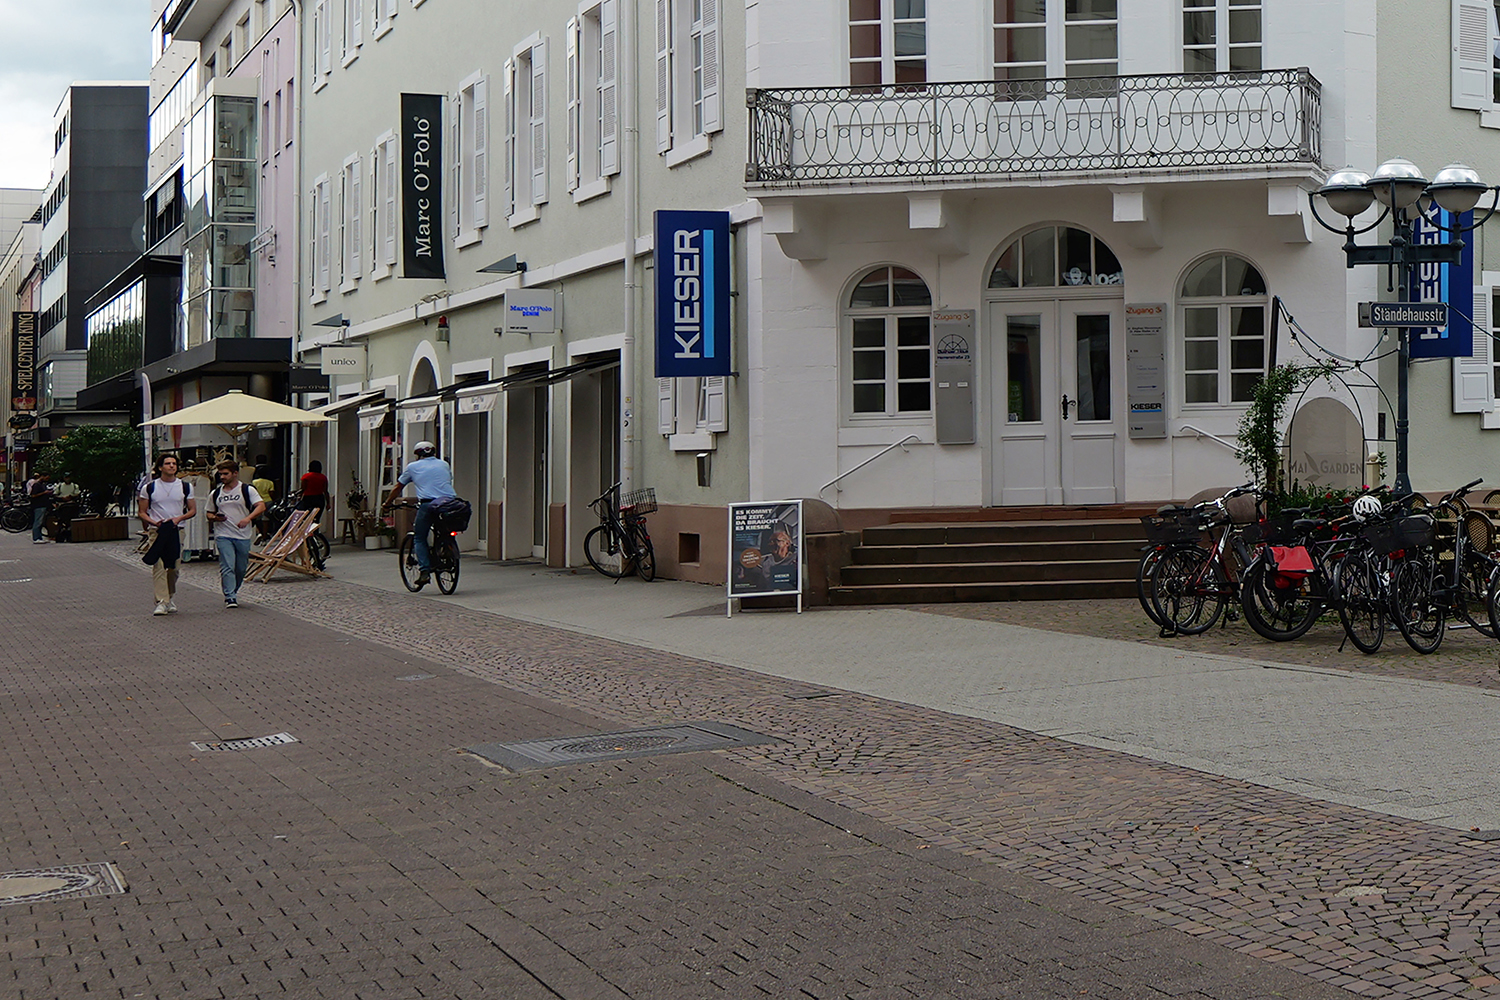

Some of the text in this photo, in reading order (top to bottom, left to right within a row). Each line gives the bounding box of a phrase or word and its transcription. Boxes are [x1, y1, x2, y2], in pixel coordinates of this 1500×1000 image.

[415, 198, 432, 258] Marc
[673, 229, 701, 359] KIESER
[1127, 306, 1161, 315] Zugang 3
[1374, 306, 1444, 322] Ständehausstr.
[935, 313, 962, 321] Zugang
[17, 313, 34, 391] SPIELCENTER KING
[330, 357, 356, 366] unico
[1130, 402, 1162, 410] KIESER
[1290, 460, 1363, 475] MAI GARDEN
[218, 494, 240, 503] POLO
